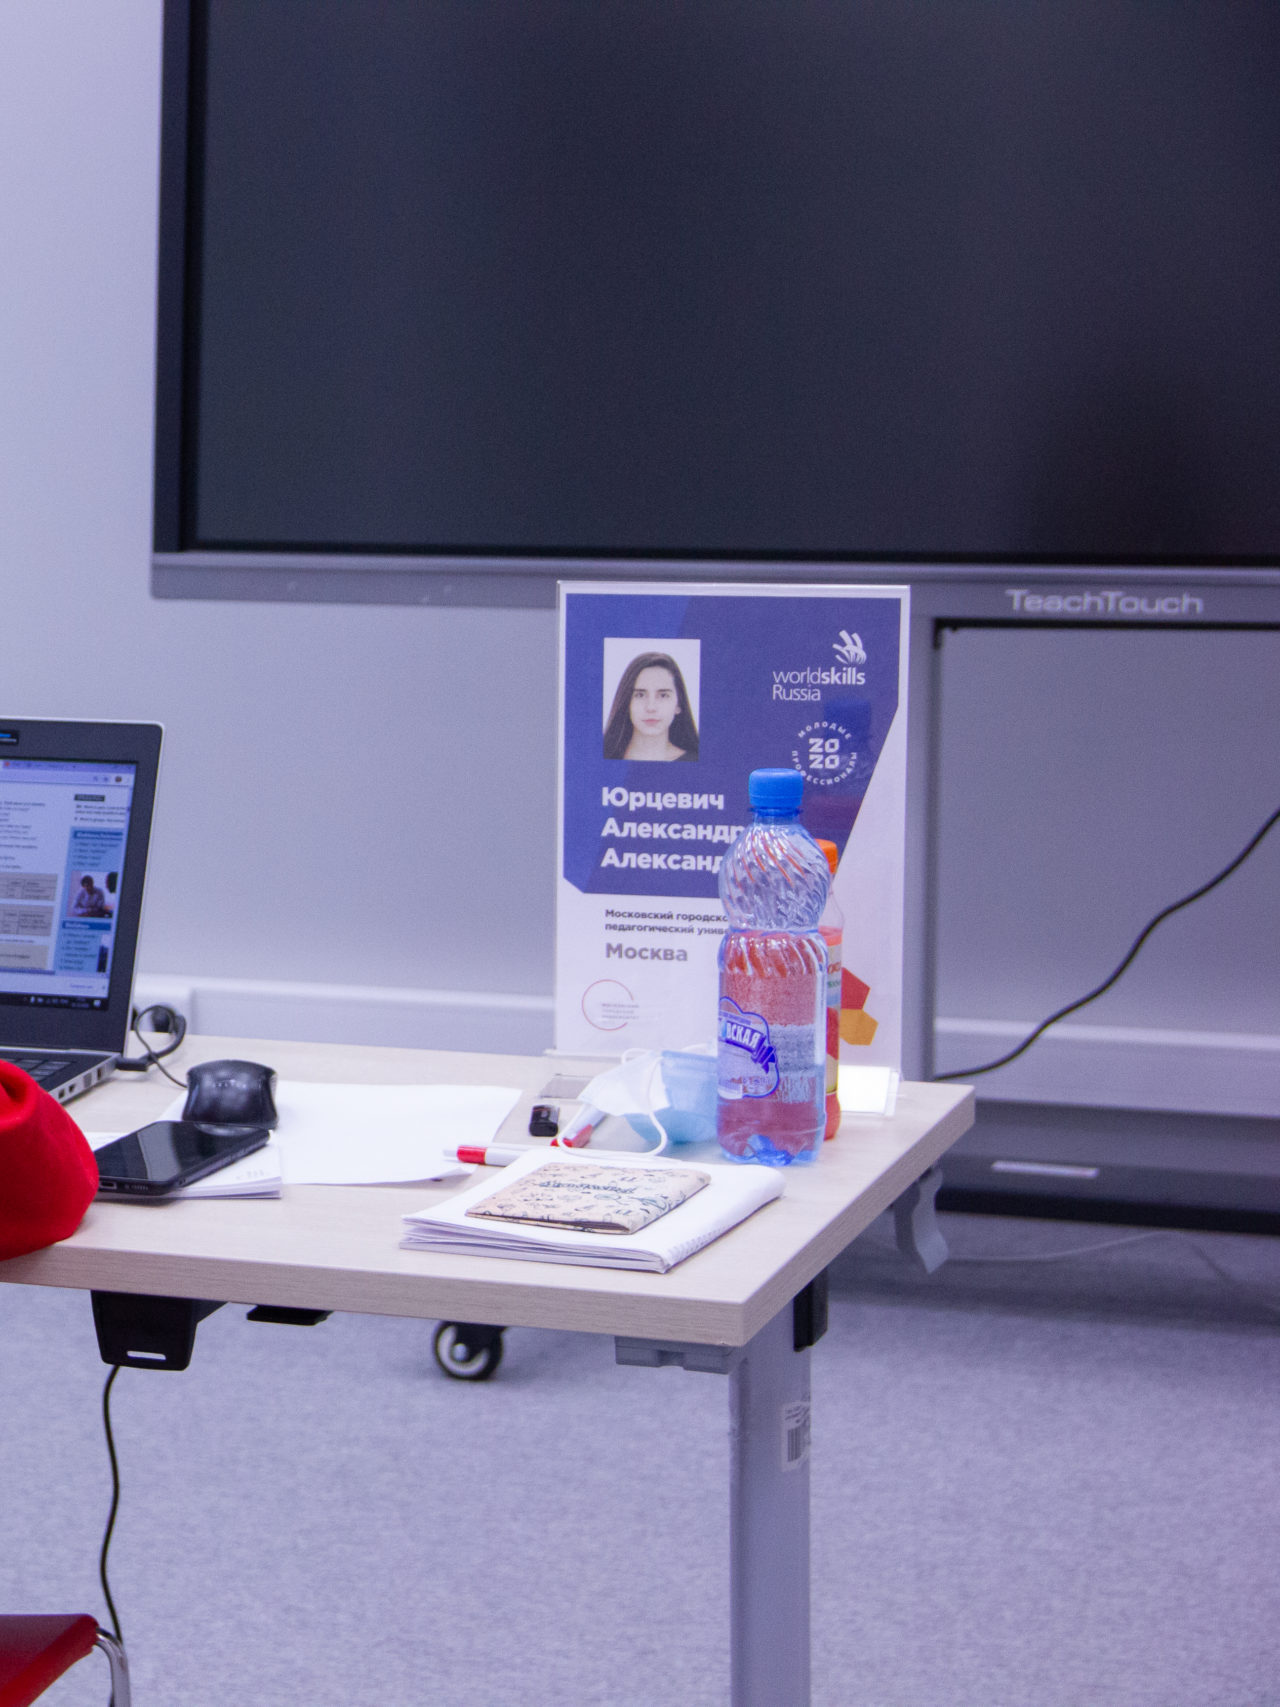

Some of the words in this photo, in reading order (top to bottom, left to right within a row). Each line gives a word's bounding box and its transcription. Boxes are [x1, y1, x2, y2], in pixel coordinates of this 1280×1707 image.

[1005, 588, 1204, 614] TeachTouch
[772, 666, 867, 686] worldskills
[772, 684, 821, 701] Russia
[797, 721, 852, 739] МОЛОДЫЕ
[601, 786, 725, 811] Юрцевич
[601, 817, 746, 844] Александр
[605, 909, 674, 921] Московский
[676, 912, 729, 923] городско
[605, 922, 694, 935] педагогический
[605, 942, 689, 962] Москва
[724, 1021, 762, 1049] ВСКАЯ
